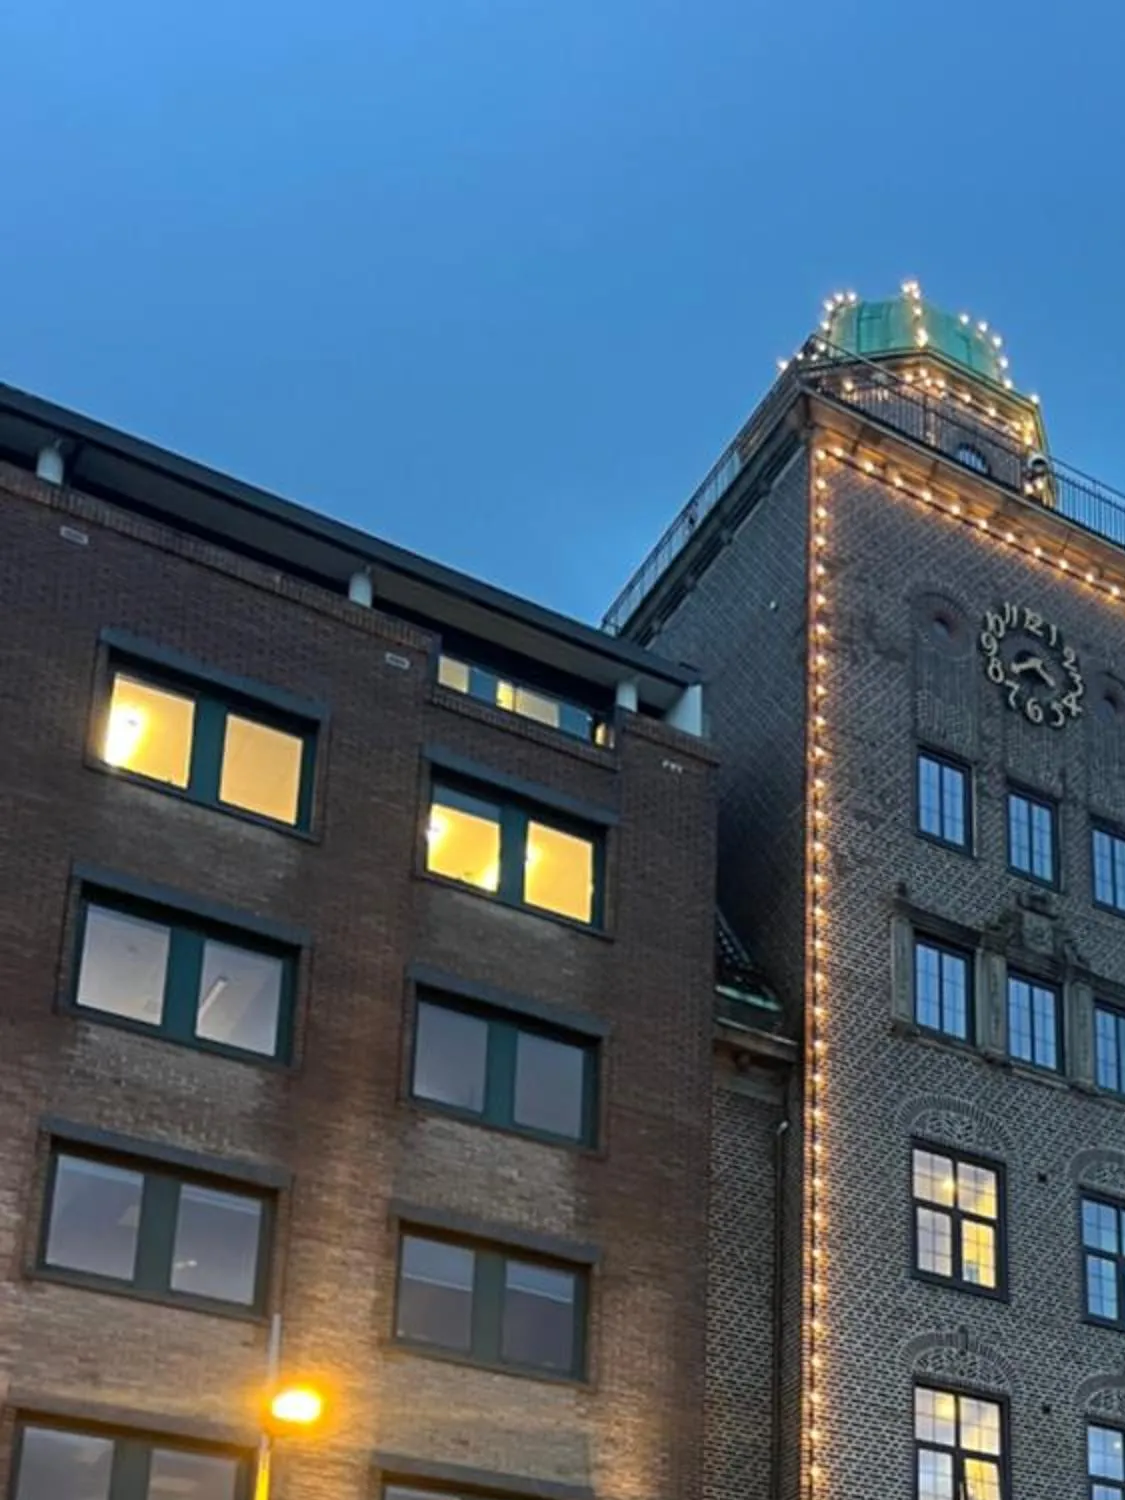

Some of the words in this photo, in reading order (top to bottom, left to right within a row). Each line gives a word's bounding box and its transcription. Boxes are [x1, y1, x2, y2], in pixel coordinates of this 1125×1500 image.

[986, 611, 1005, 638] 10
[1004, 601, 1018, 627] 11
[1024, 607, 1044, 636] 12
[981, 632, 998, 656] 9
[1049, 624, 1057, 646] 1
[988, 657, 1004, 683] 8
[1062, 646, 1077, 671] 2
[1004, 680, 1019, 708] 7
[1069, 671, 1083, 696] 3
[1026, 698, 1043, 723] 6
[1050, 701, 1065, 727] 5
[1062, 691, 1082, 716] 4
